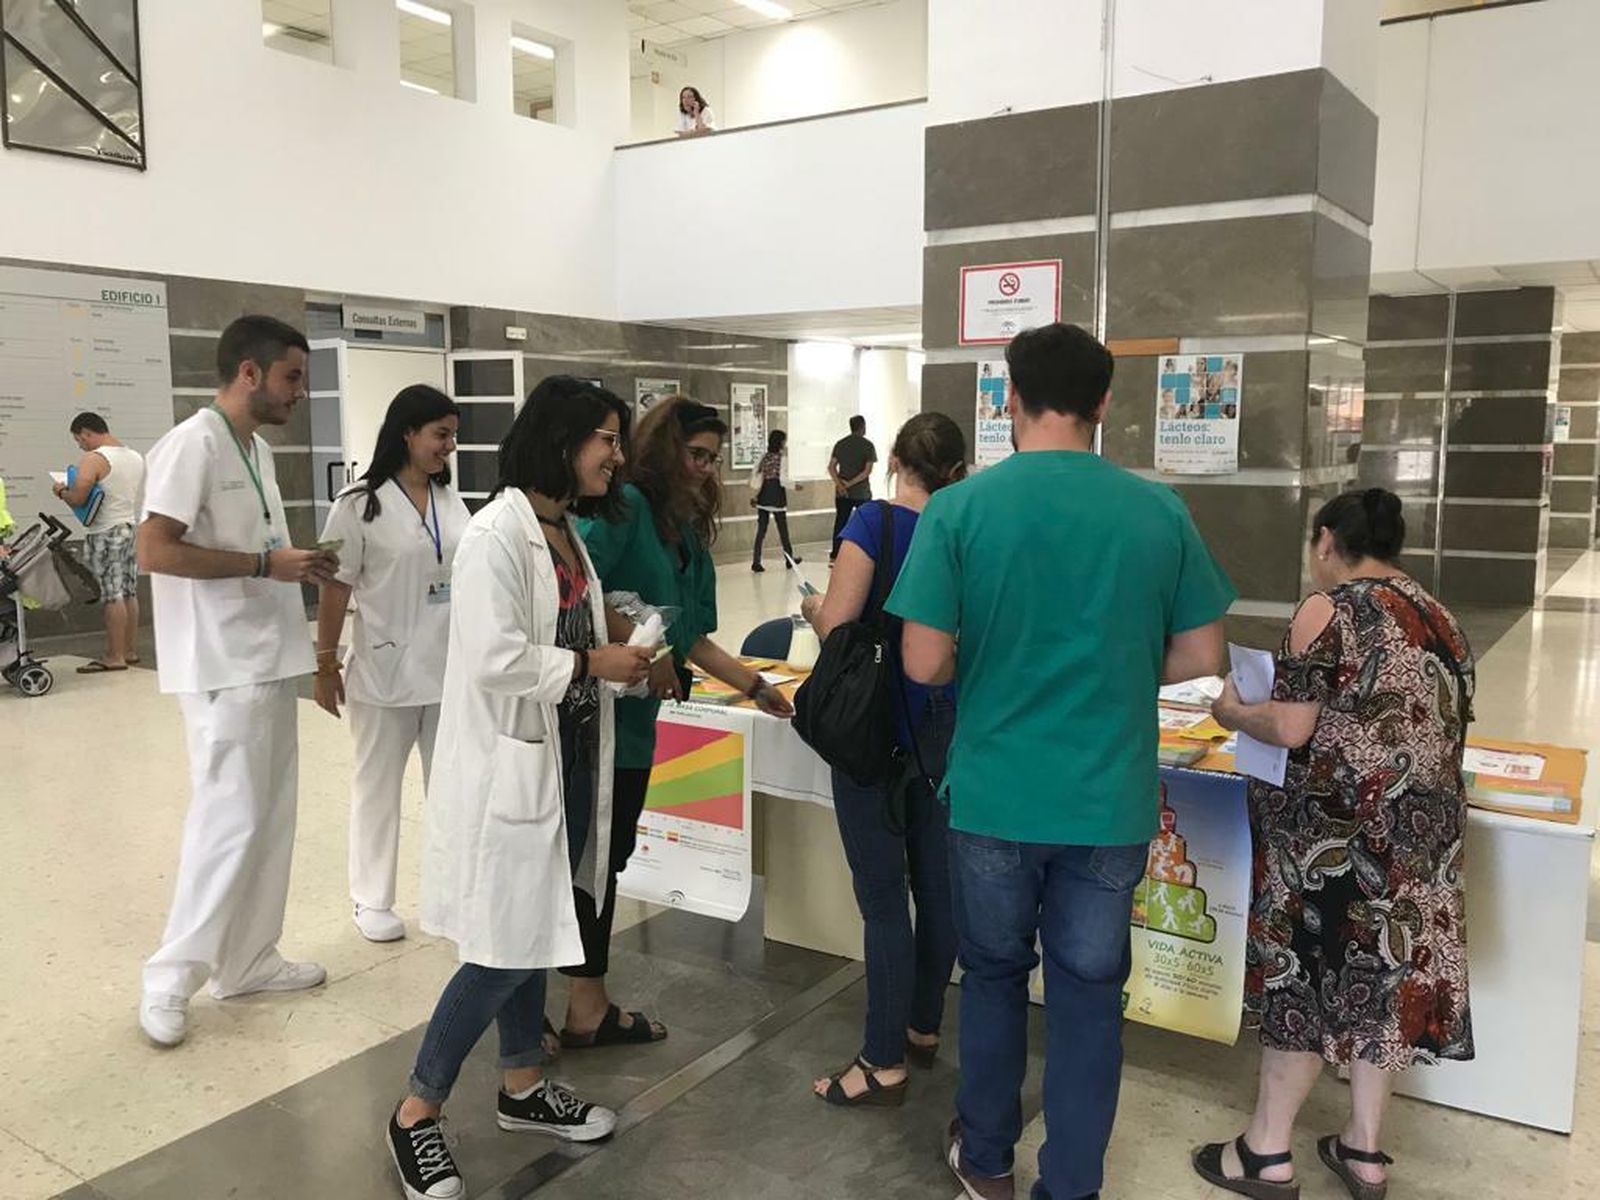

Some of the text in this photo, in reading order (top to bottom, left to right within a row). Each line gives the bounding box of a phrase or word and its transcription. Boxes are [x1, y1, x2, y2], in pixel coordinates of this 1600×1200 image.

[101, 289, 152, 304] EDIFICIO
[352, 312, 418, 330] Consultas Externas
[979, 432, 1006, 443] tenlo
[1159, 433, 1226, 445] tenlo claro
[1148, 939, 1223, 966] VIDA ACTIVA
[1153, 952, 1180, 968] 30x5
